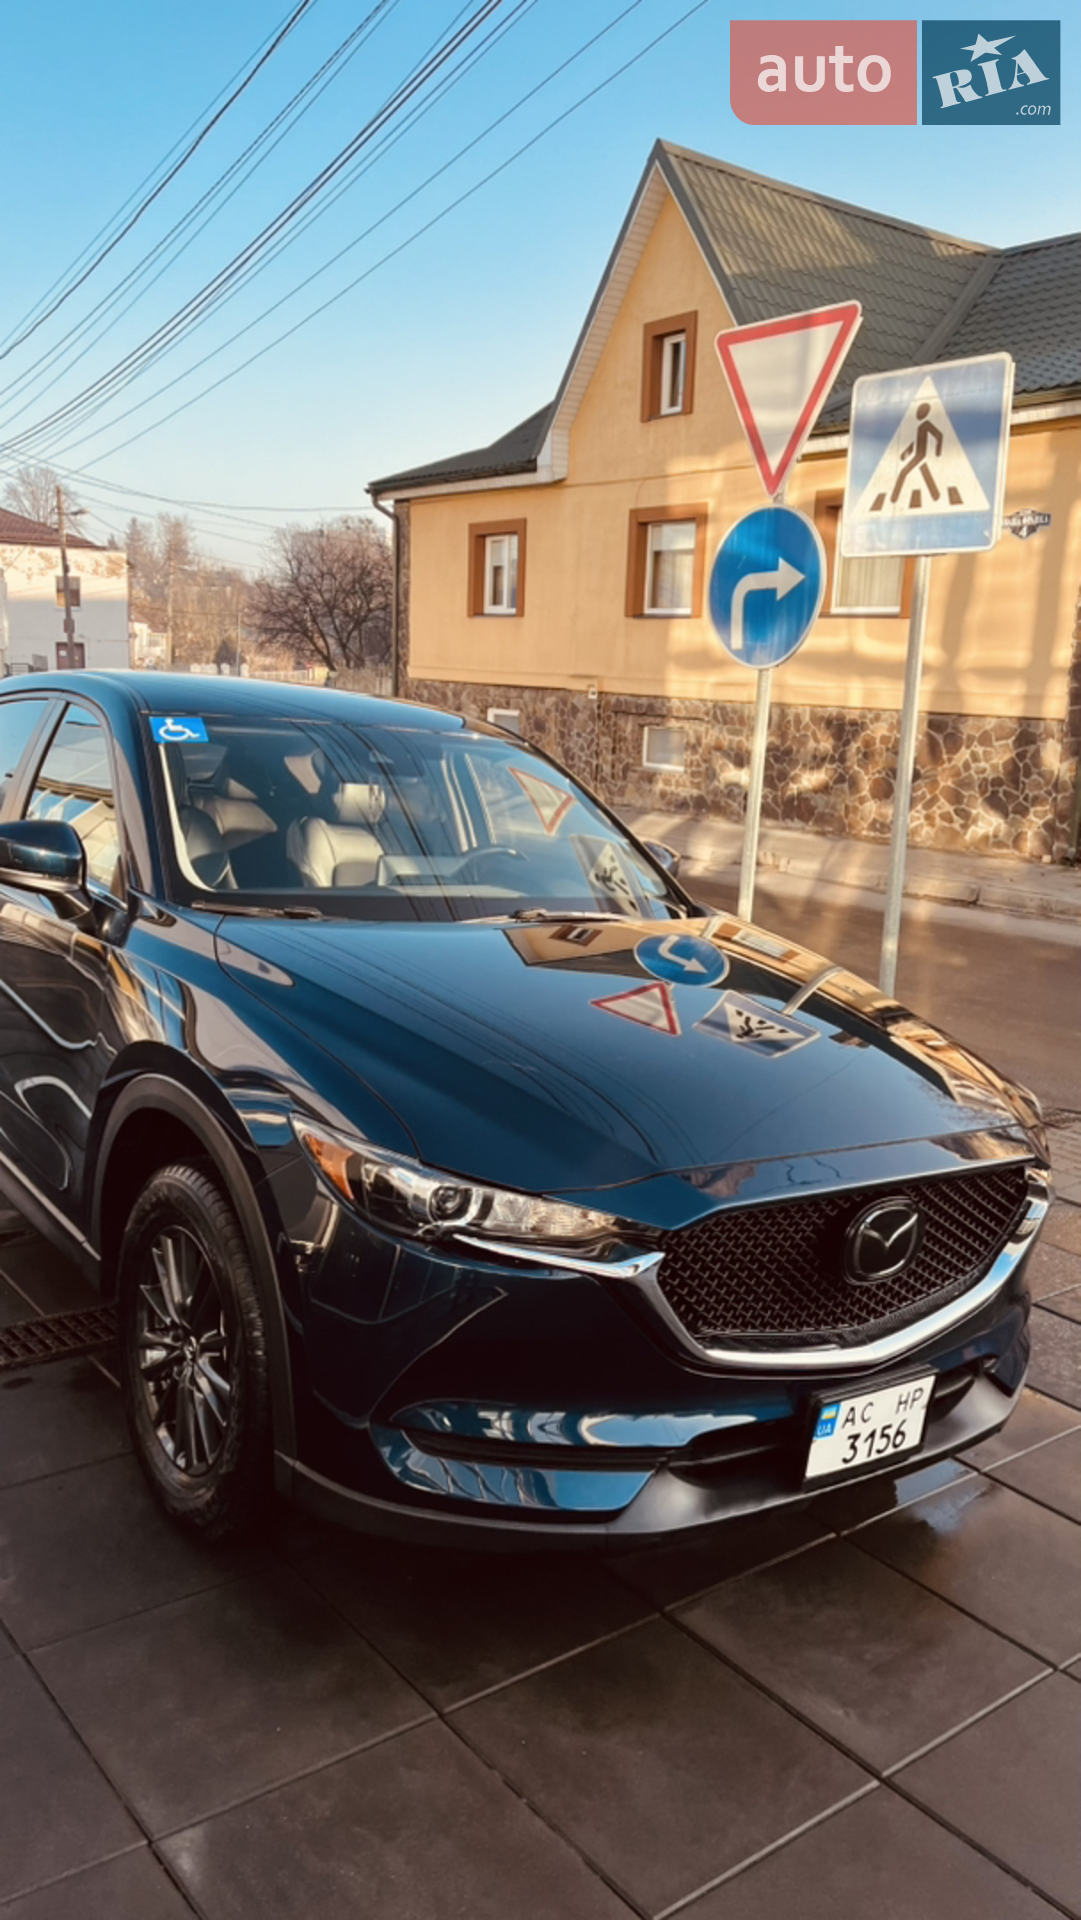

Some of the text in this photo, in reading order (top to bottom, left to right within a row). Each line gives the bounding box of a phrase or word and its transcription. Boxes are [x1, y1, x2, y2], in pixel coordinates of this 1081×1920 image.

[842, 1387, 924, 1429] AC HP
[842, 1419, 907, 1464] 3156
